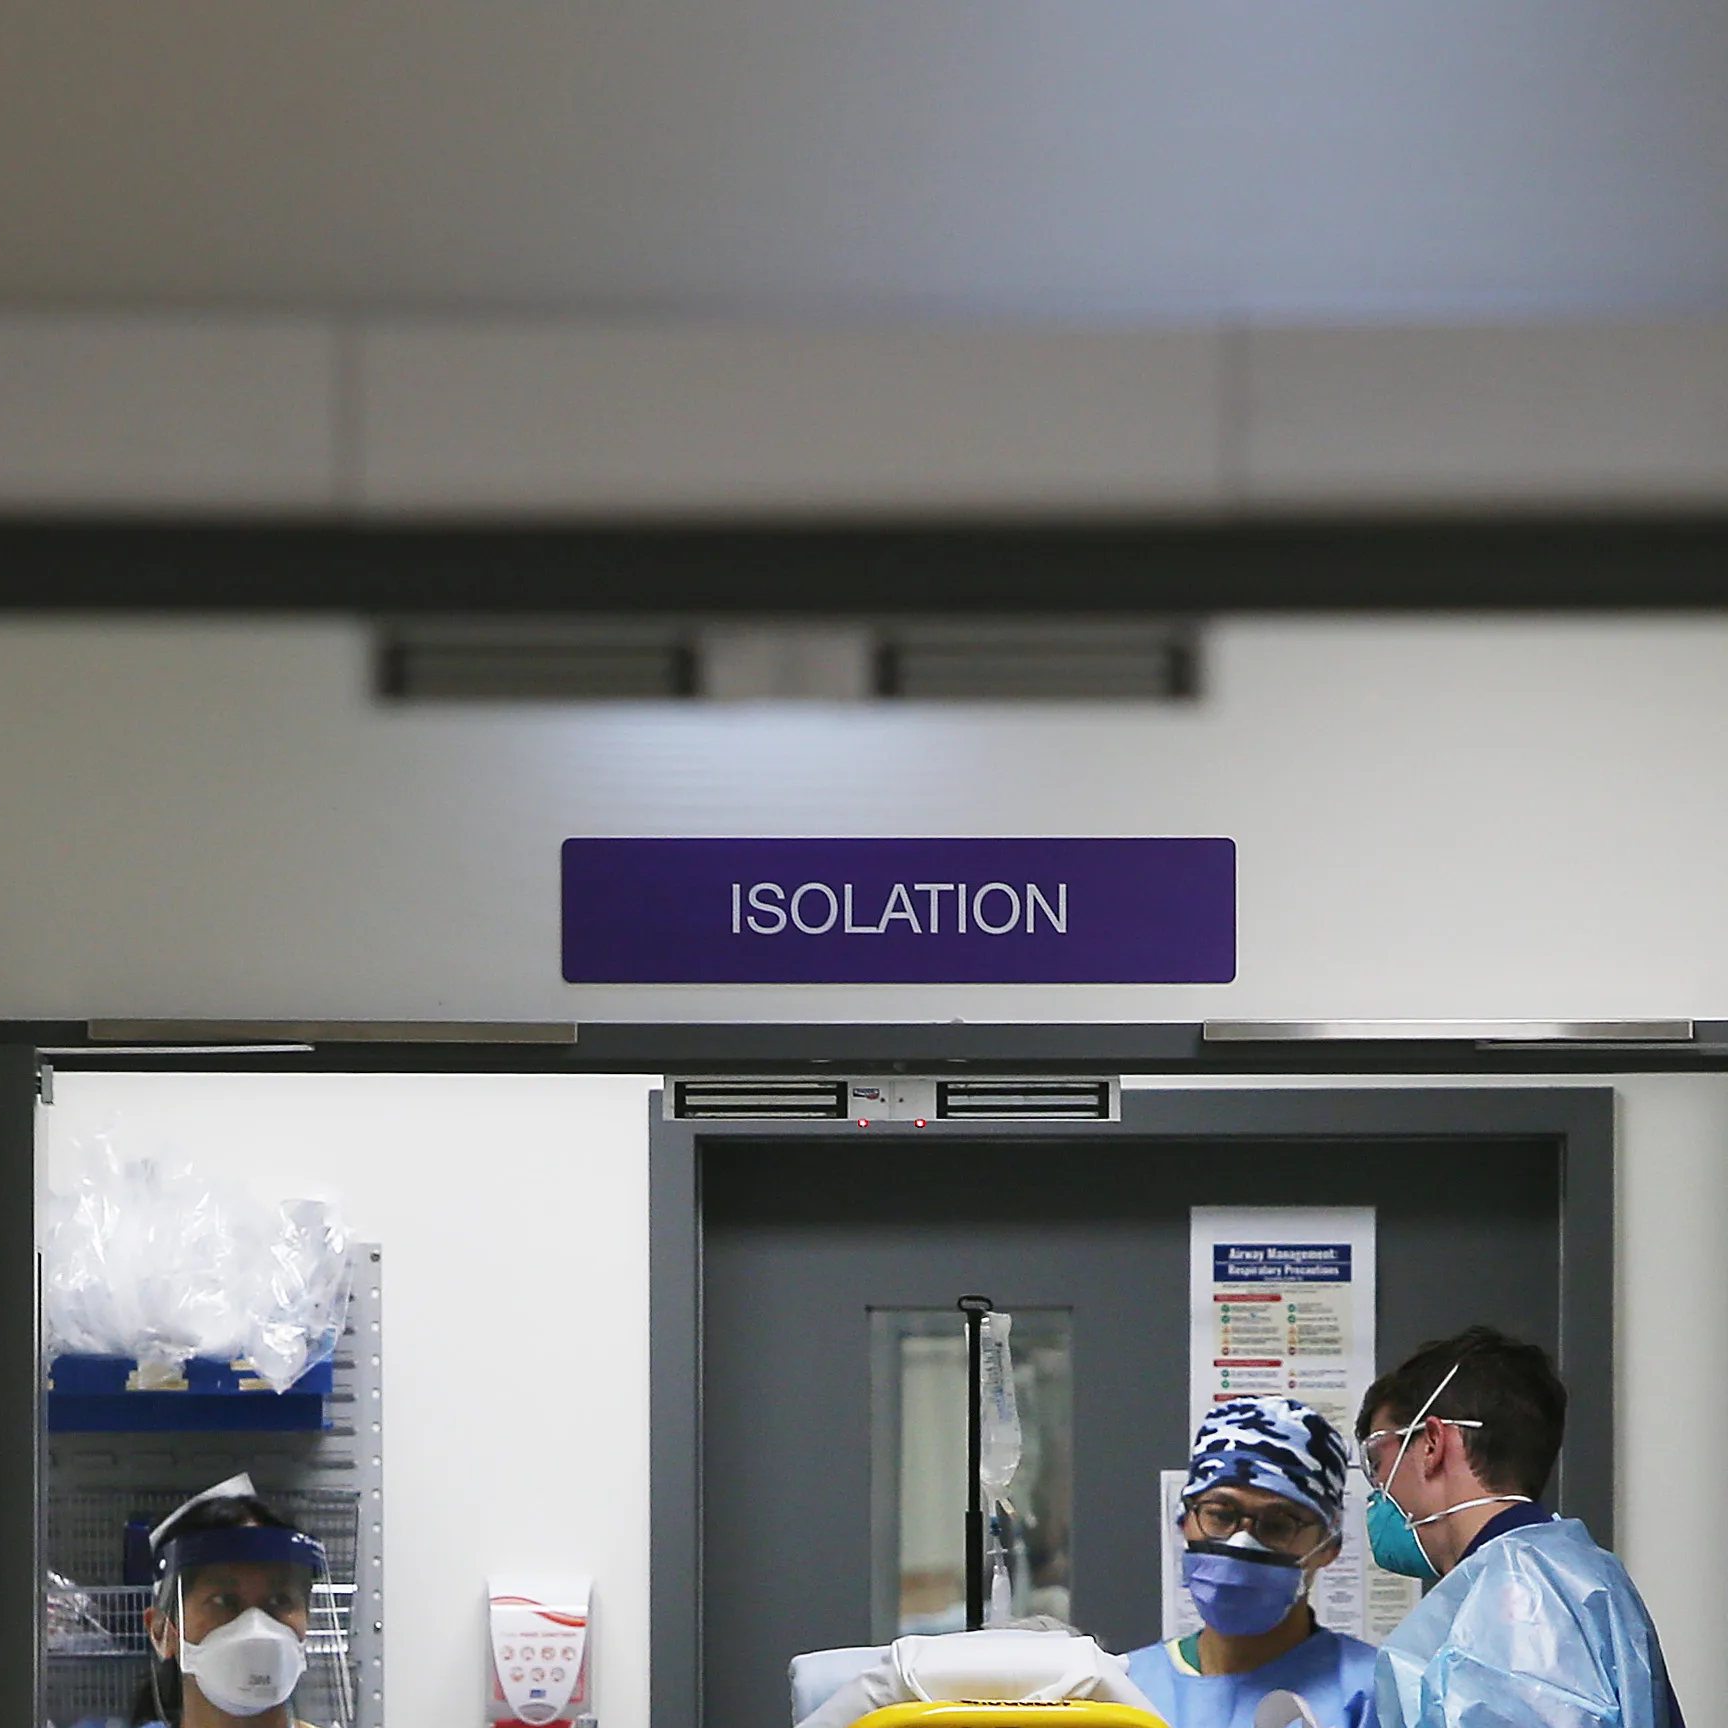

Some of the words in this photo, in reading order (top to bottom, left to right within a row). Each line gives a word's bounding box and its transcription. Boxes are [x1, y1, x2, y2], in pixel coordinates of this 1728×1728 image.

[731, 882, 1069, 936] ISOLATION
[1228, 1247, 1265, 1262] Airway
[1228, 1263, 1281, 1276] Respiratory
[1283, 1263, 1340, 1275] Precautions
